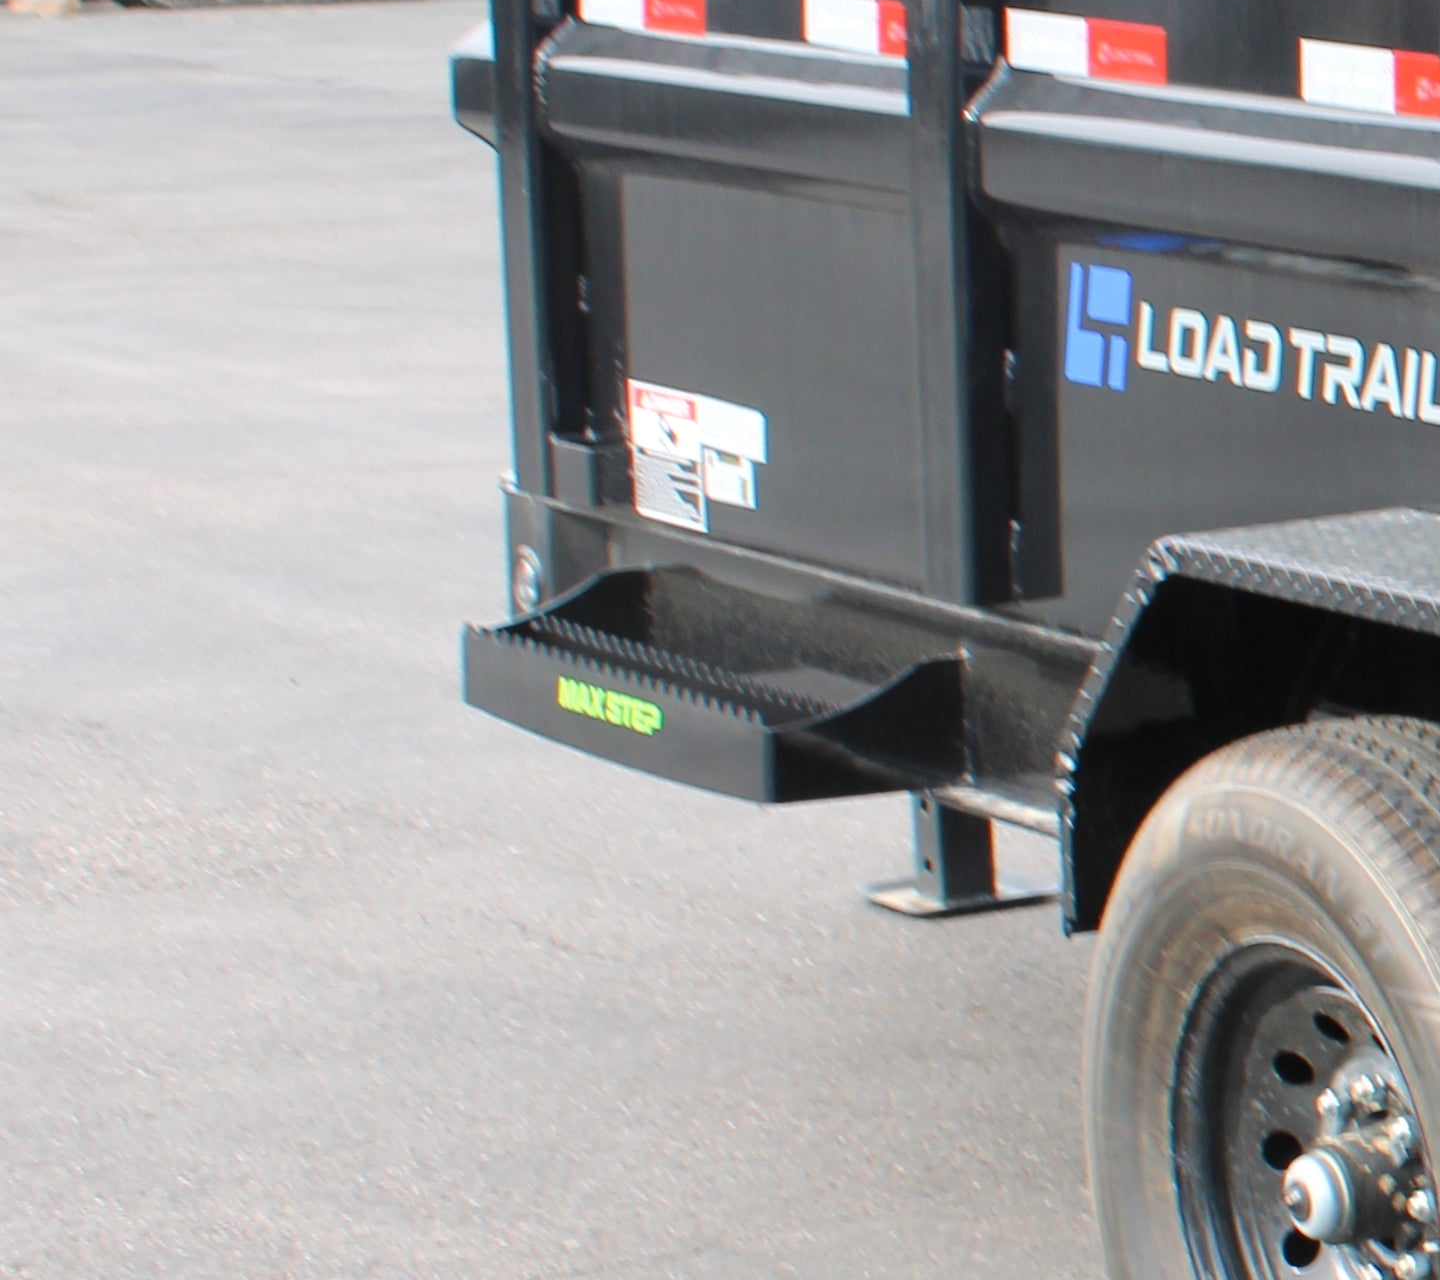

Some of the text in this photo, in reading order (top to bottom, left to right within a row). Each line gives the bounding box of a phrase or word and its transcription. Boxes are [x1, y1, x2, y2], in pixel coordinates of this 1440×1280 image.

[1136, 300, 1283, 393] LOAD
[558, 675, 663, 736] MAX STEP
